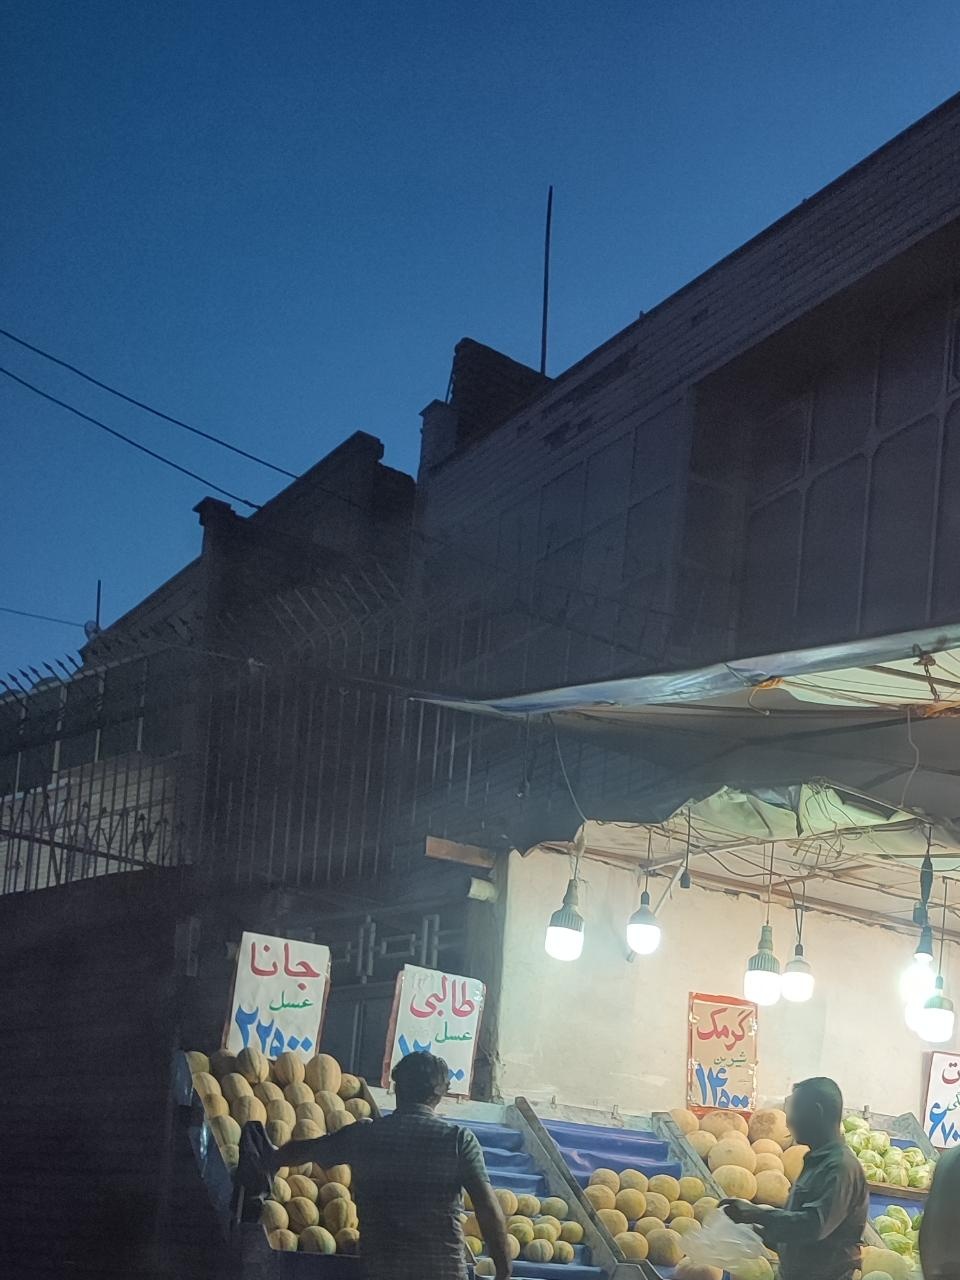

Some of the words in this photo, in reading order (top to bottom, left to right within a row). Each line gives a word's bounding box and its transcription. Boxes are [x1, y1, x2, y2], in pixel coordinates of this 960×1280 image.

[251, 942, 320, 991] جانا
[269, 991, 313, 1011] عسل
[410, 975, 475, 1018] طالبی
[435, 1021, 472, 1043] عسل
[697, 1007, 754, 1051] گرمک
[695, 1063, 749, 1108] ۱۴۵۰۰
